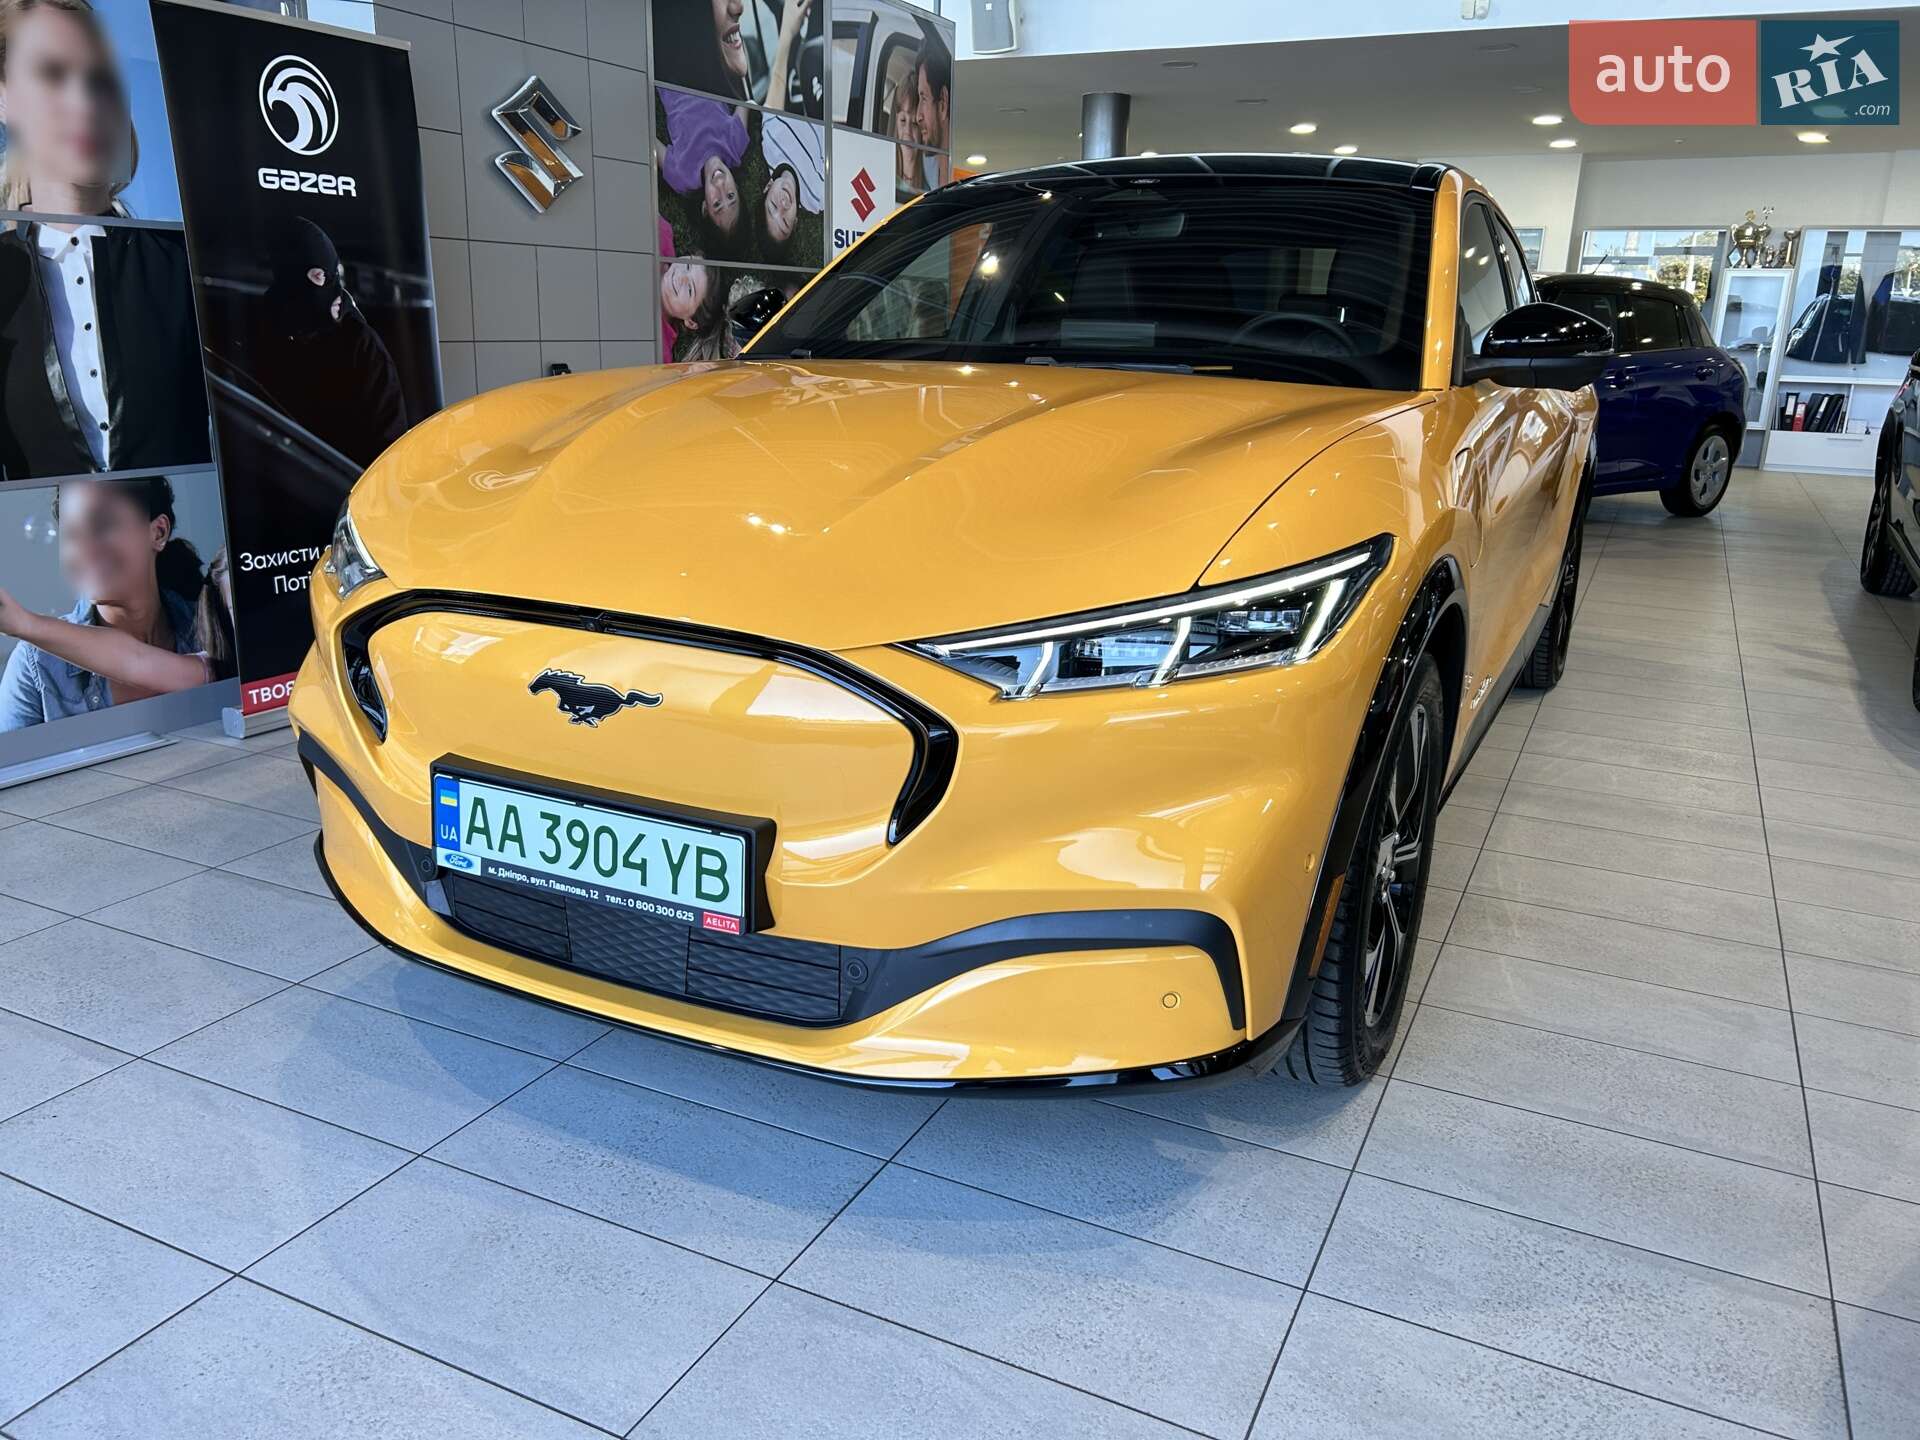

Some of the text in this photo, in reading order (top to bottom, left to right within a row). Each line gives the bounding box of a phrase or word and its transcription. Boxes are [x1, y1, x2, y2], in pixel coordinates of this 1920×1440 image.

[240, 547, 320, 571] Захисти
[440, 823, 458, 842] UA
[465, 796, 730, 903] AA 3904 YB
[590, 889, 599, 900] 12
[636, 900, 655, 912] 800
[655, 904, 675, 917] 300
[676, 909, 695, 922] 625
